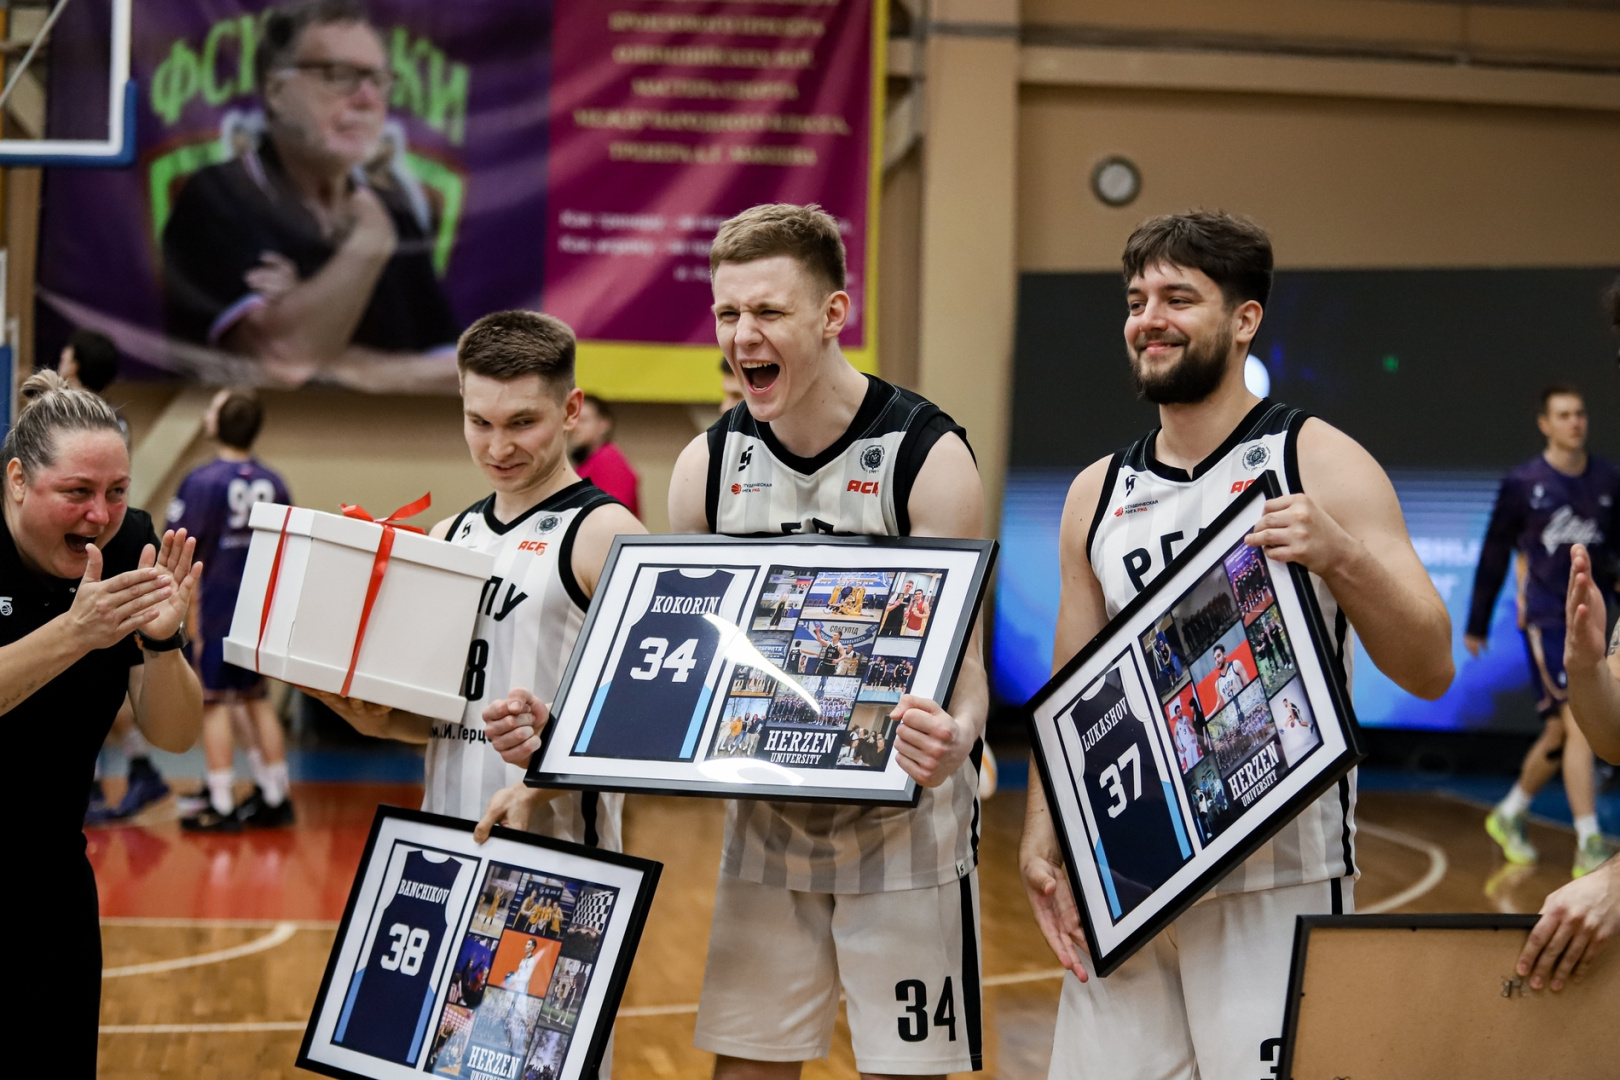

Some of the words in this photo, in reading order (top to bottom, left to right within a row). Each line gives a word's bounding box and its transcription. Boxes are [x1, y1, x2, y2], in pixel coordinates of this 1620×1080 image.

[1122, 527, 1207, 593] РГ
[477, 575, 529, 622] ПУ
[651, 595, 720, 615] KOKORIN
[629, 636, 699, 683] 34
[457, 723, 493, 745] Герц
[763, 730, 838, 754] HERZEN
[1082, 697, 1128, 752] LUKASHOV
[769, 752, 822, 765] UNIVERSITY
[1099, 742, 1142, 819] 37
[1228, 740, 1280, 801] HERZEN
[1241, 769, 1278, 807] UNIVERSITY
[398, 879, 450, 905] BANCHIKOV
[380, 923, 430, 977] 38
[895, 976, 957, 1043] 34
[467, 1045, 521, 1080] HERZEN
